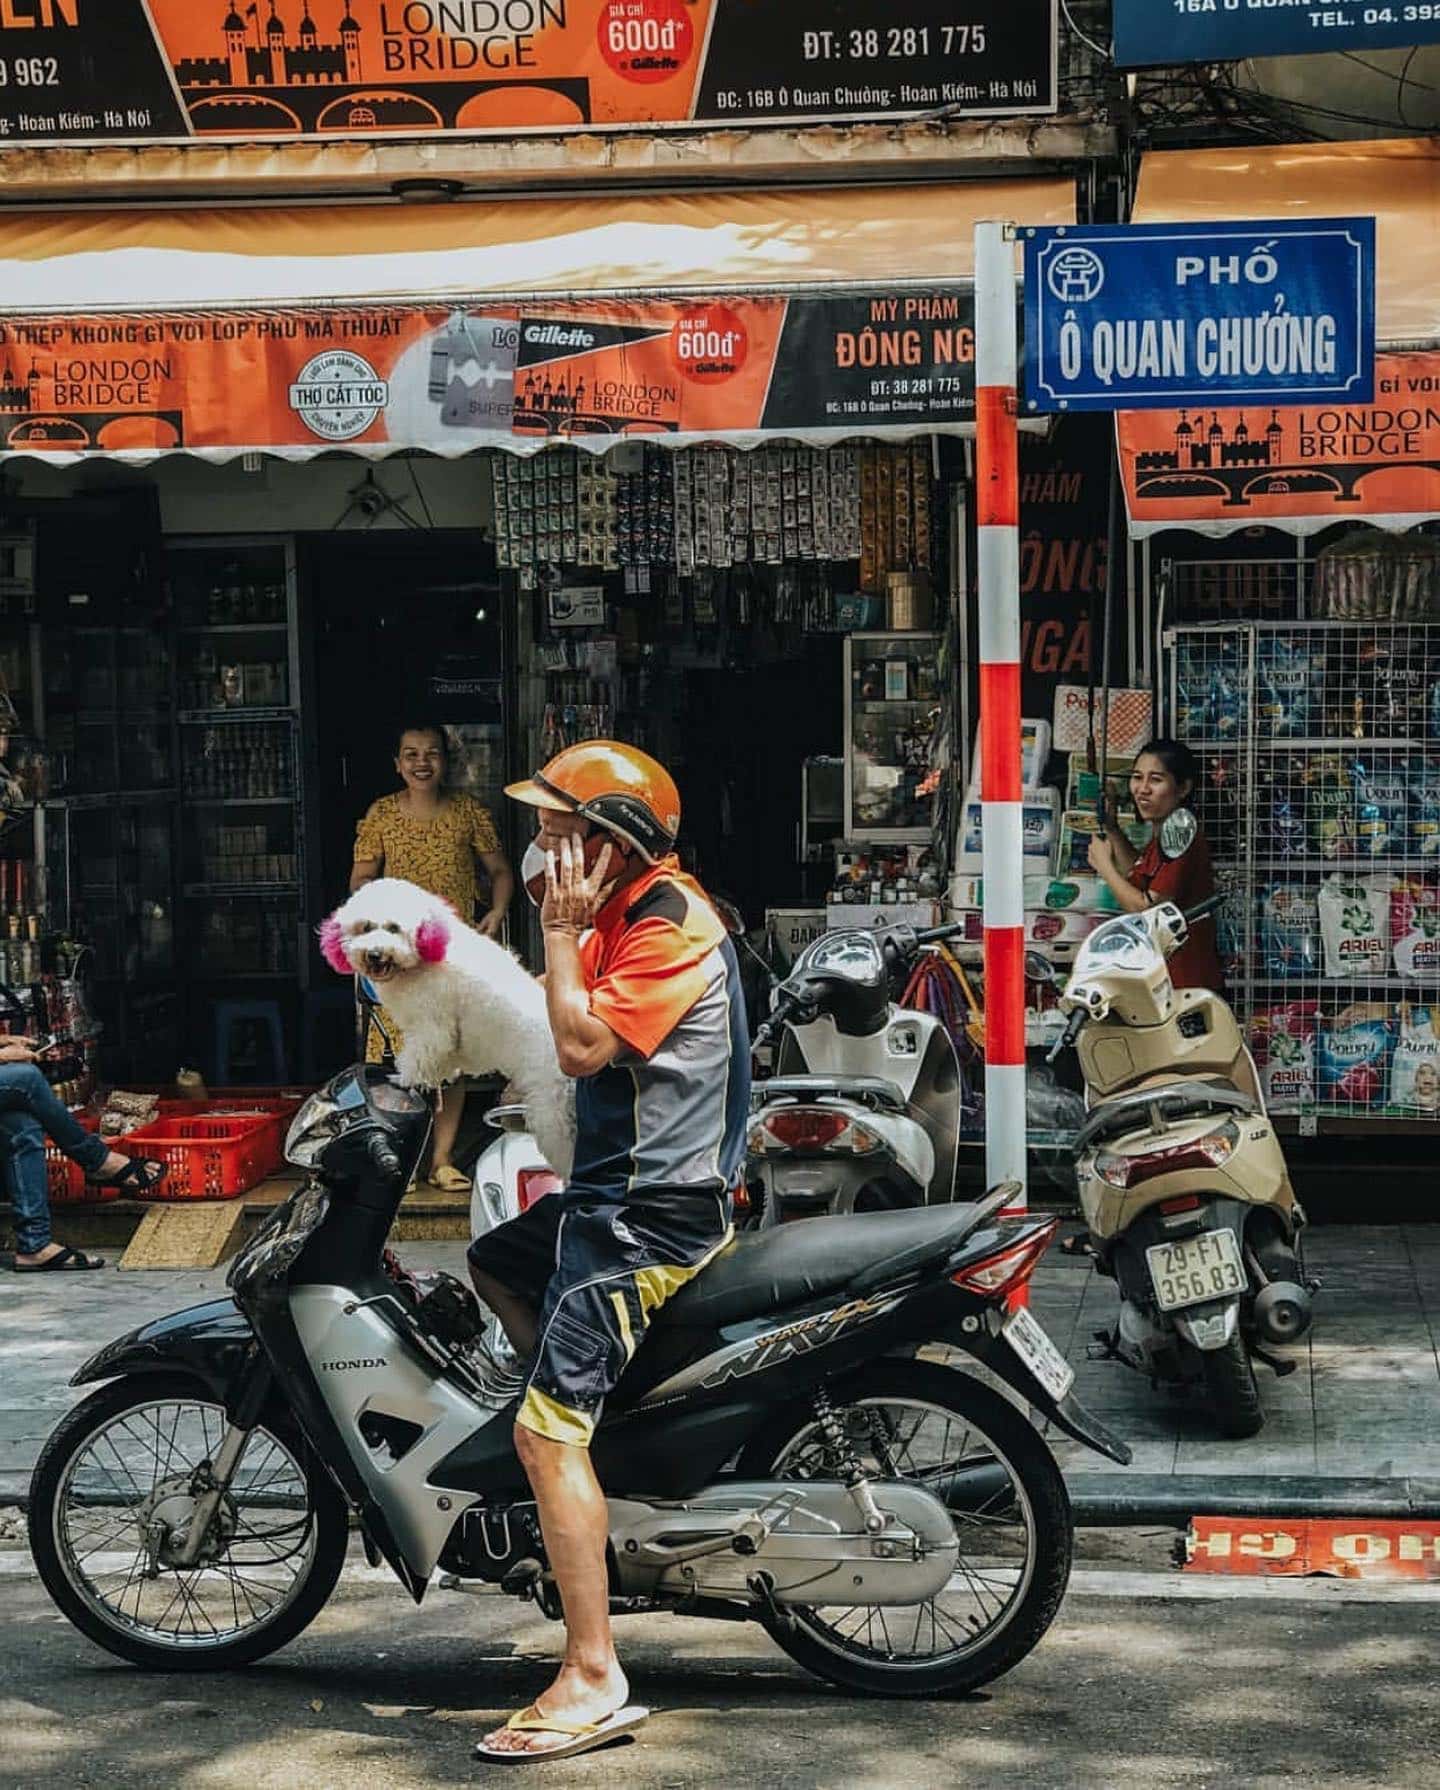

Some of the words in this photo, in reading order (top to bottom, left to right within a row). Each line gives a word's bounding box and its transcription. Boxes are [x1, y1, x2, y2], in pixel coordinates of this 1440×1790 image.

[381, 0, 567, 35] LONDON
[1309, 12, 1354, 27] TEL.
[384, 34, 537, 71] BRIDGE
[803, 31, 841, 60] ĐT:
[850, 30, 879, 58] 38
[887, 28, 929, 56] 281
[941, 25, 986, 53] 775
[15, 57, 59, 87] 962
[793, 88, 830, 105] Quan
[1176, 240, 1278, 286] PHỐ
[524, 325, 595, 347] Gillette
[836, 326, 921, 368] ĐÔNG
[934, 327, 976, 364] NG
[1059, 308, 1082, 381] Ô
[1093, 318, 1186, 385] QUAN
[1197, 293, 1337, 377] CHƯỞNG
[53, 357, 171, 383] LONDON
[54, 382, 151, 406] BRIDGE
[593, 381, 676, 403] LONDON
[893, 380, 908, 394] 38
[911, 379, 932, 394] 281
[938, 378, 960, 392] 775
[592, 397, 662, 417] BRIDGE
[1300, 408, 1440, 433] LONDON
[1300, 431, 1420, 458] BRIDGE
[1020, 530, 1111, 593] ÔNG
[1338, 939, 1385, 953] ARIEL
[1160, 1237, 1223, 1274] 29-F1
[1162, 1263, 1239, 1304] 356.83
[321, 1358, 388, 1372] HONDA
